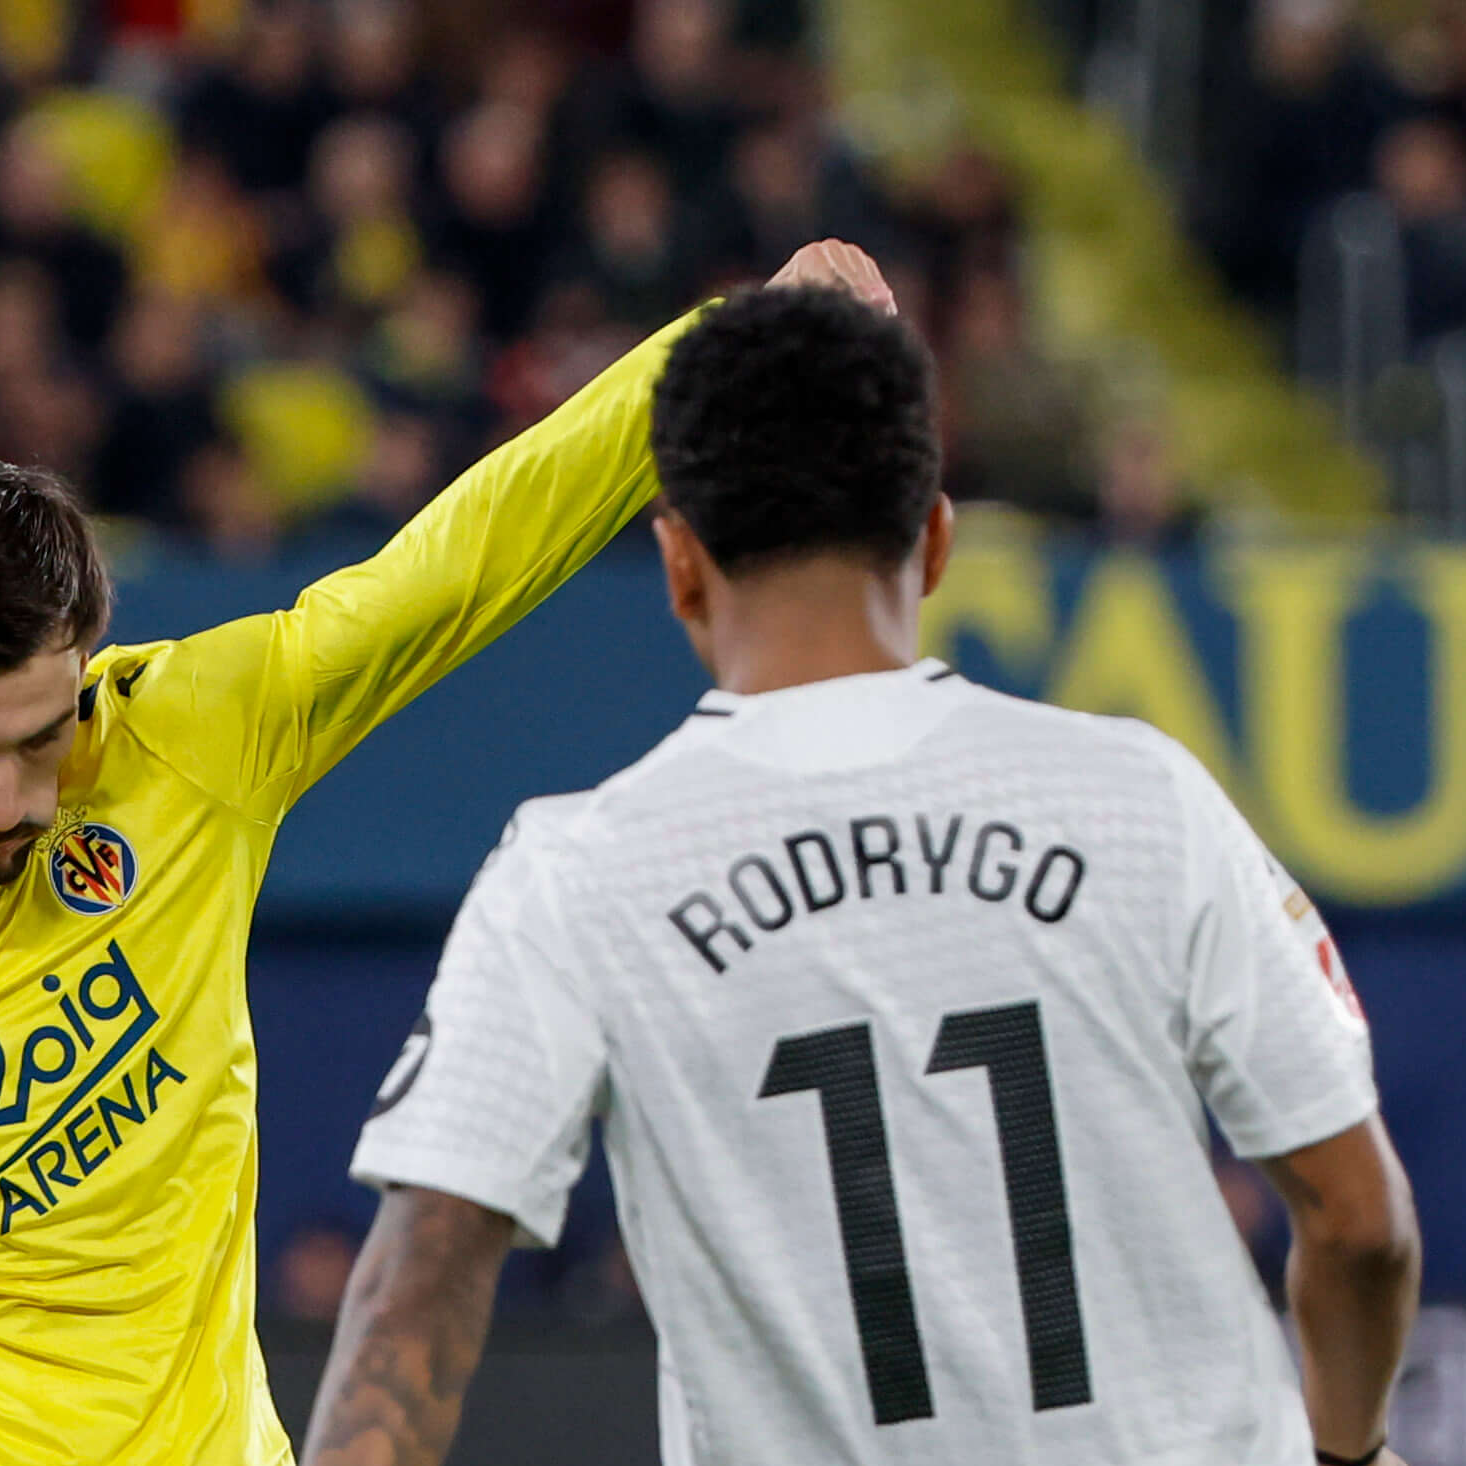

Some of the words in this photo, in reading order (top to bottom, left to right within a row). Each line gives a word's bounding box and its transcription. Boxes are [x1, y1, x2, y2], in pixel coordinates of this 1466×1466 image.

[668, 814, 1087, 975] RODRYGO
[0, 1047, 187, 1236] ARENA
[757, 1000, 1094, 1426] 11
